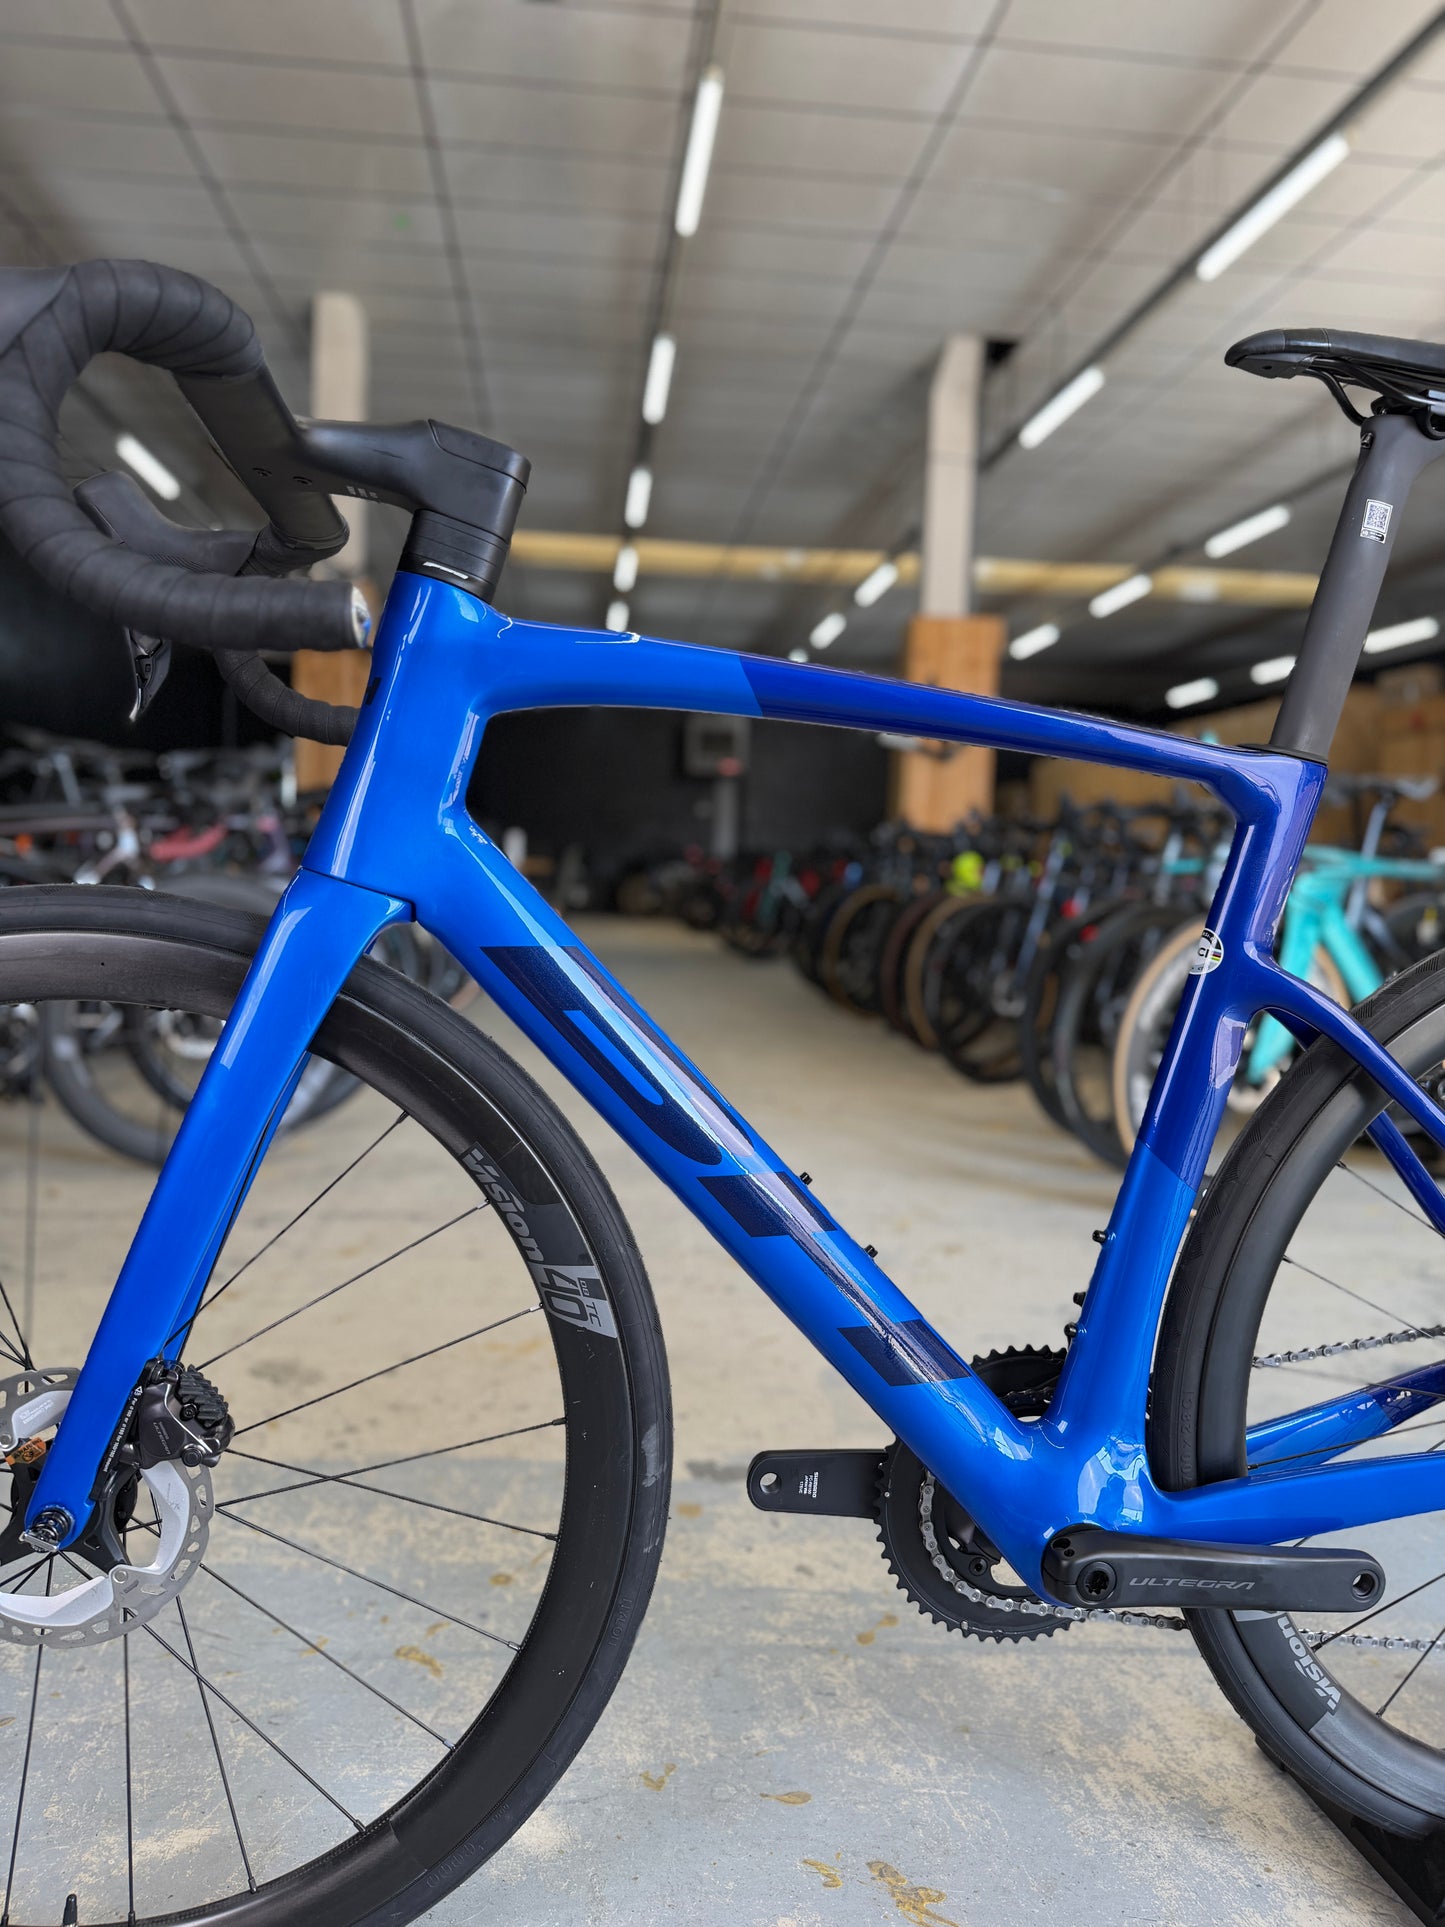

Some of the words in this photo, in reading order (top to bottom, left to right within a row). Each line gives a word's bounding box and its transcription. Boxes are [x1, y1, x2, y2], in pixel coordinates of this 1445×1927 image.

[461, 1148, 544, 1262] Vision
[540, 1267, 589, 1321] 40
[585, 1301, 602, 1327] TC
[1129, 1577, 1256, 1590] ULTEGRA
[1277, 1616, 1342, 1711] Vision
